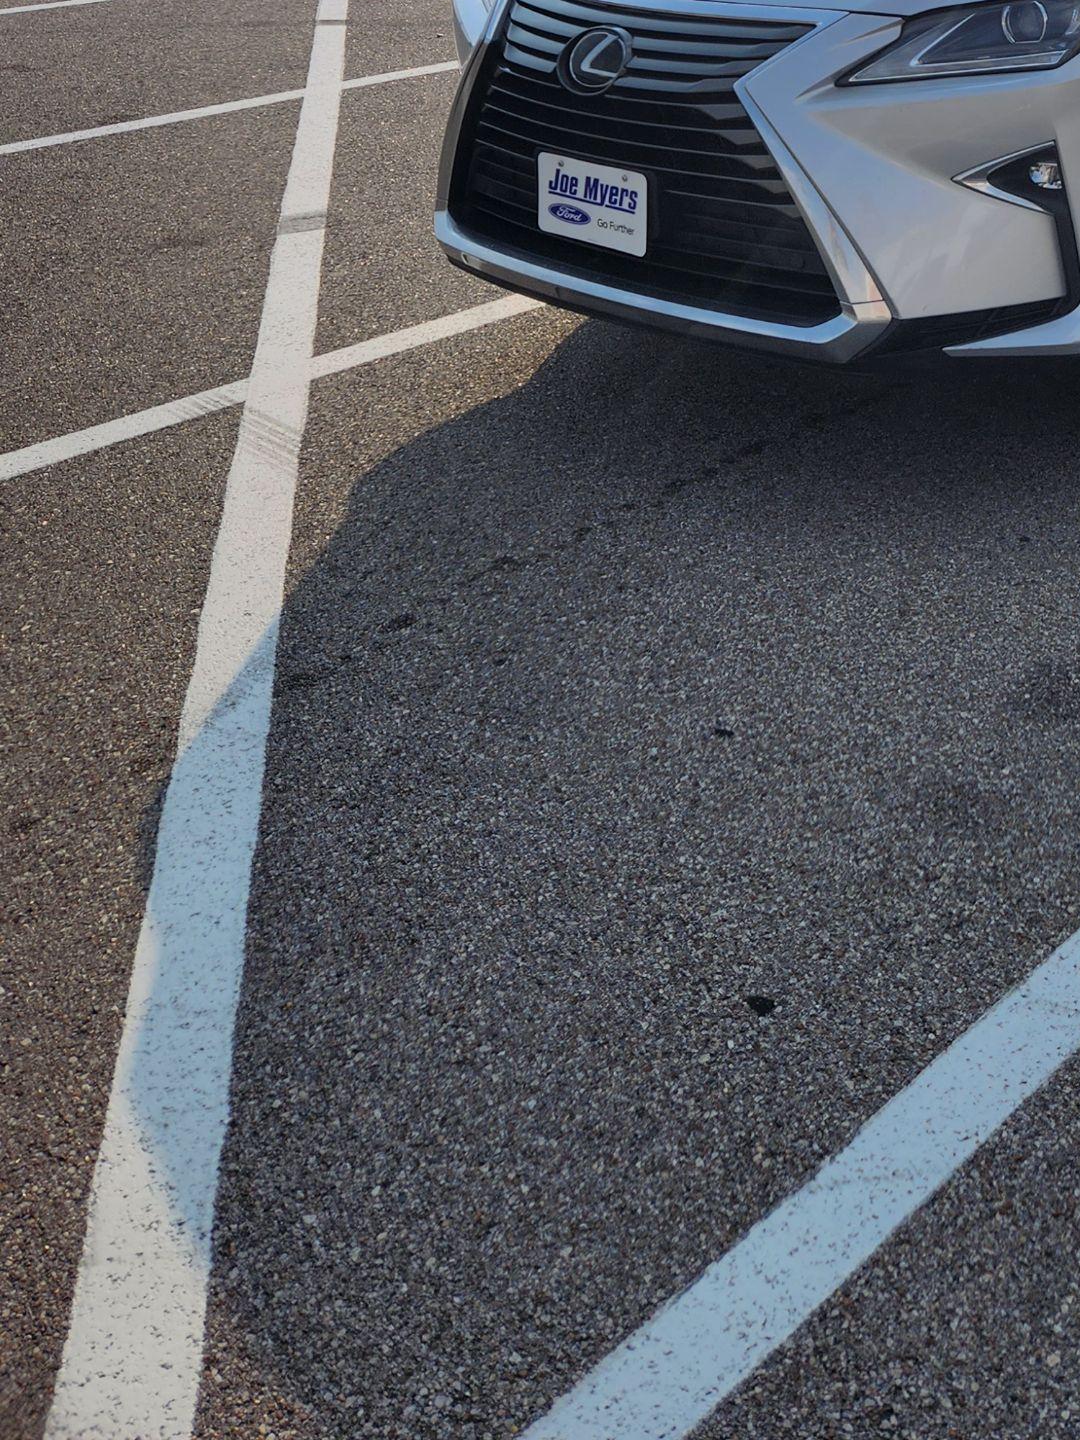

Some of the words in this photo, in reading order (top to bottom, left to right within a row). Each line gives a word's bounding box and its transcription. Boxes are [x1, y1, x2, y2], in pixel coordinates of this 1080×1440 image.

[548, 168, 579, 195] Joe
[583, 175, 638, 210] Myers
[556, 205, 583, 222] Ford
[597, 218, 608, 229] Go
[609, 221, 635, 236] Further
